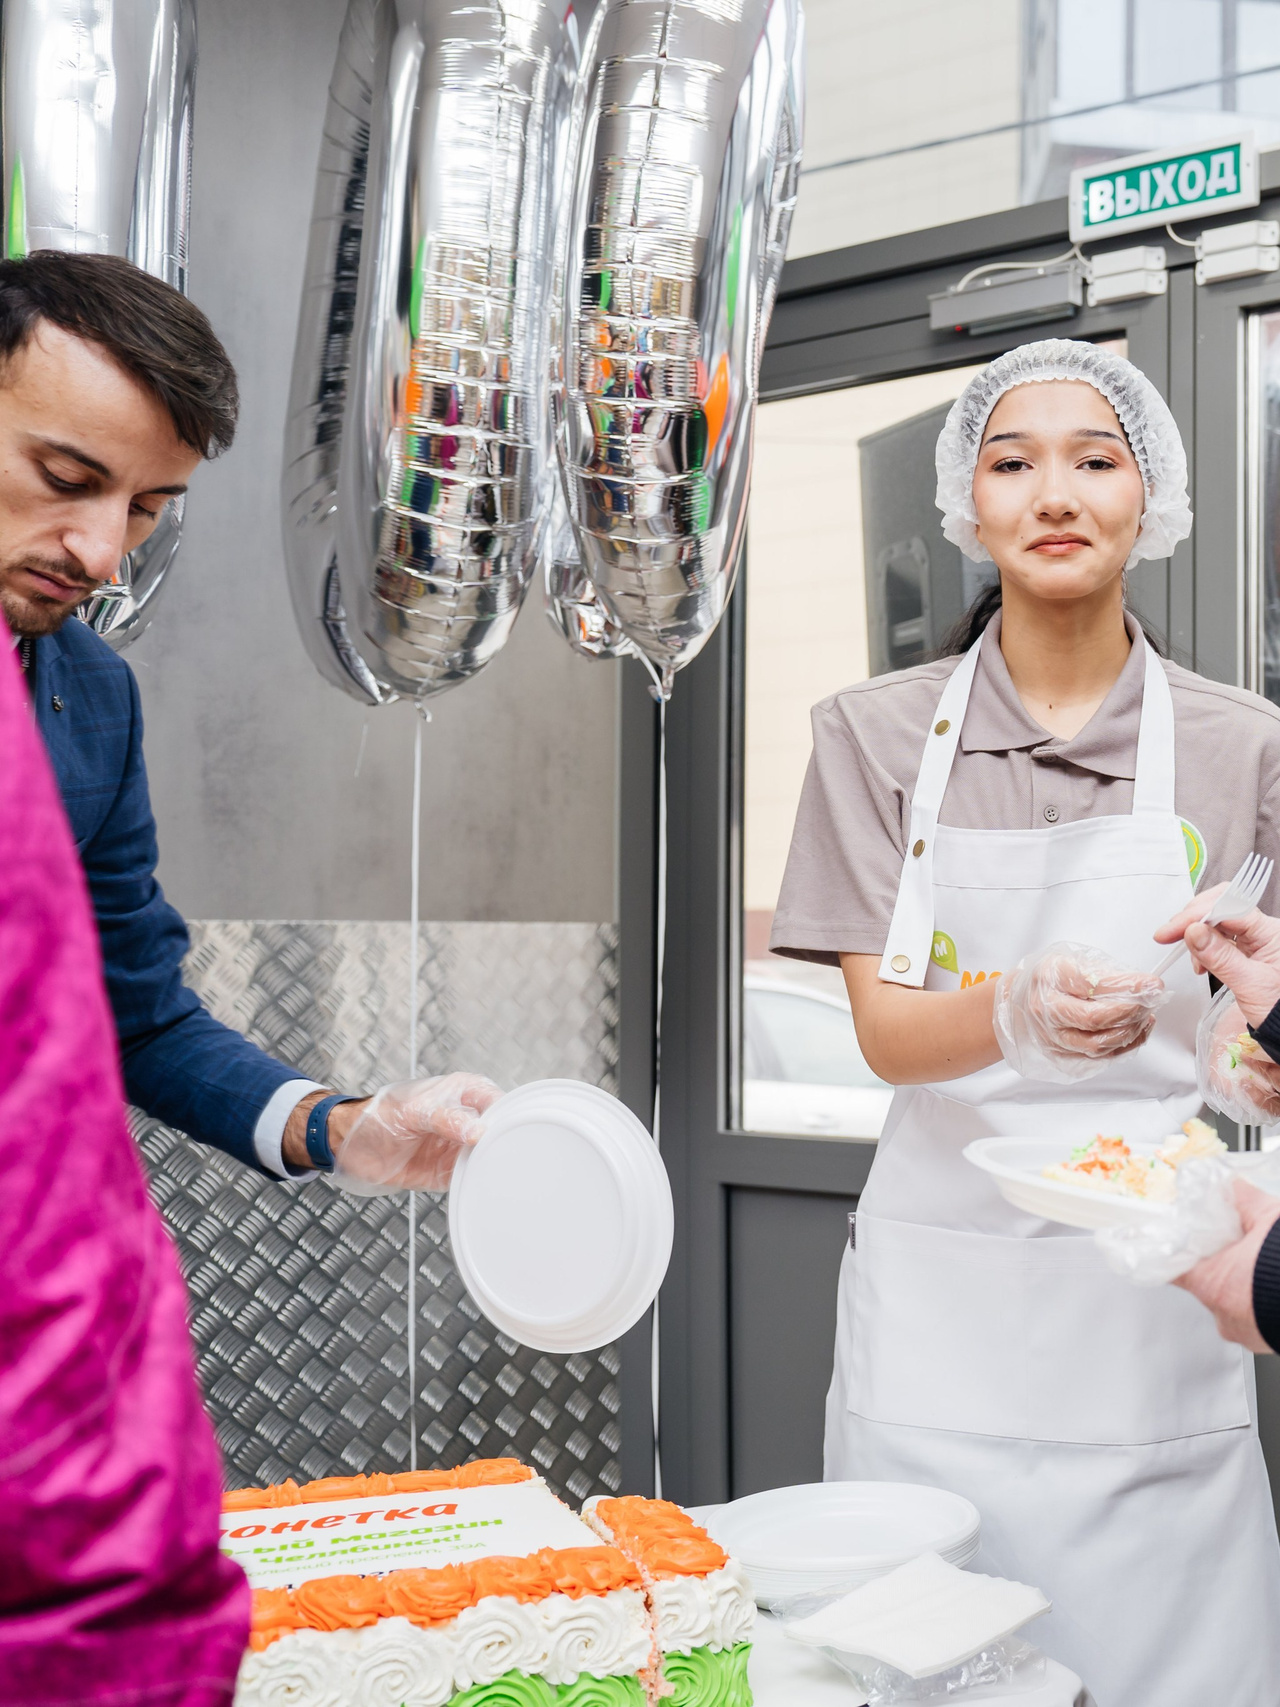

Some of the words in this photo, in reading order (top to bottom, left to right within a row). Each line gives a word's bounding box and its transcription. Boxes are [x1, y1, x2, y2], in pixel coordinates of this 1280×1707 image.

[1088, 151, 1237, 223] ВЫХОД
[934, 940, 948, 958] М
[219, 1503, 459, 1538] онетка
[331, 1519, 503, 1545] магазин
[259, 1534, 462, 1563] Челябинск!
